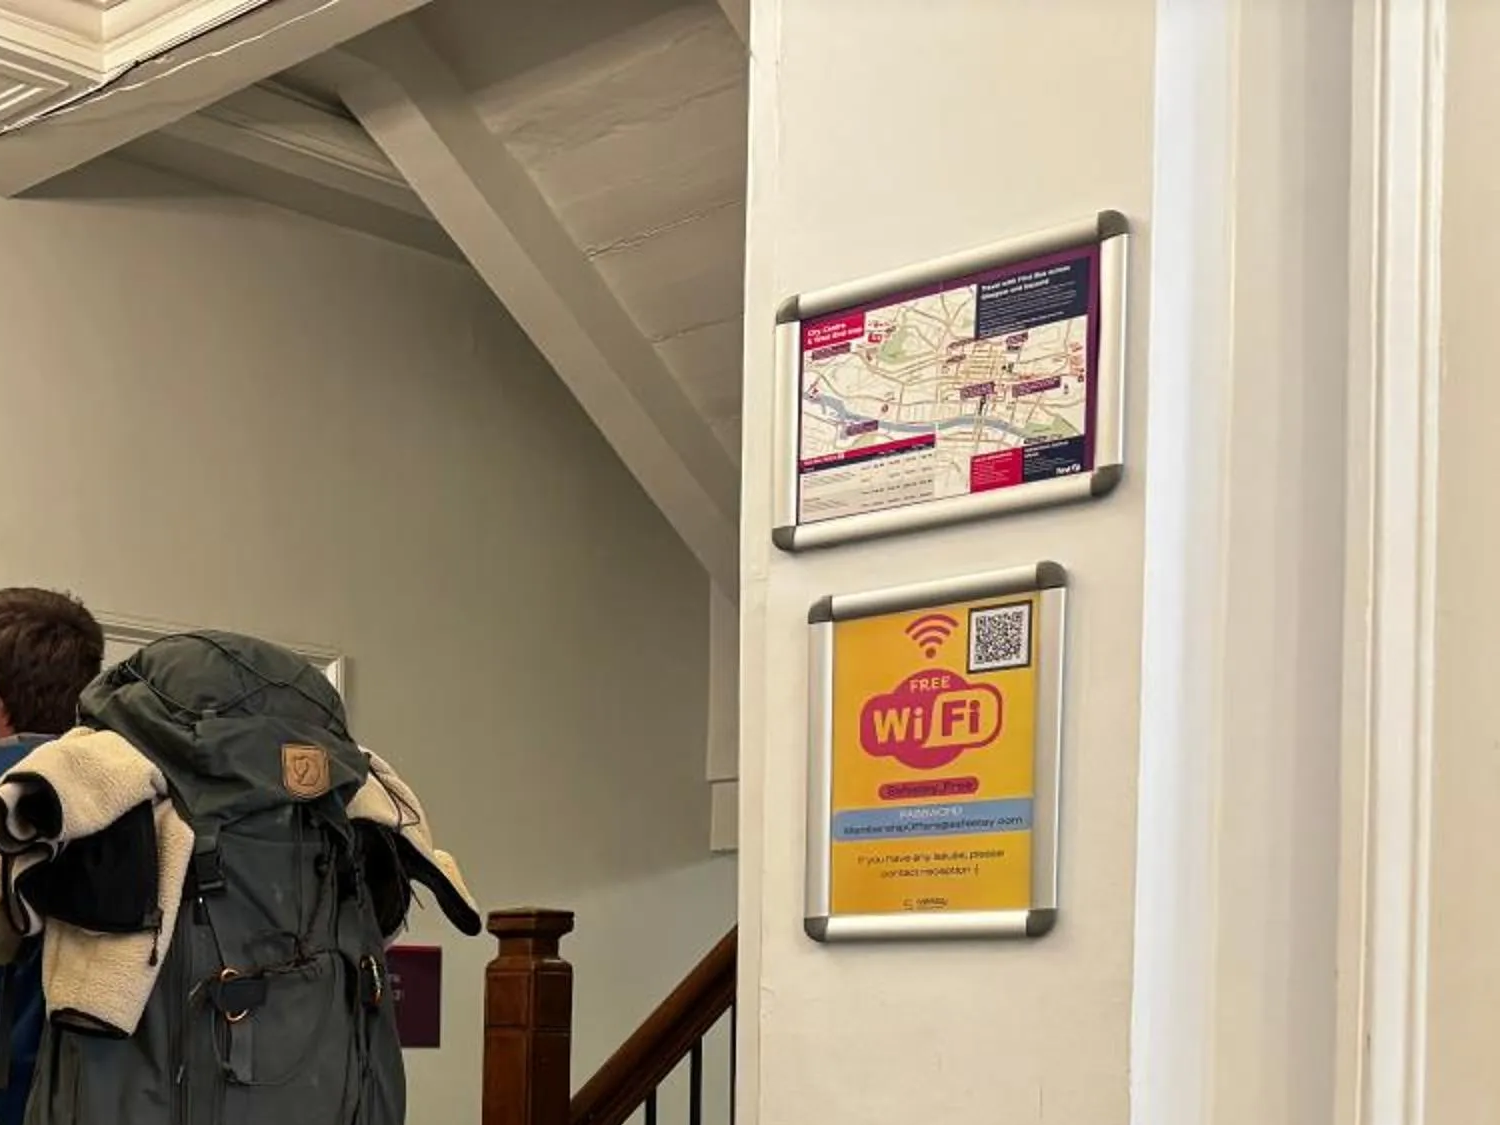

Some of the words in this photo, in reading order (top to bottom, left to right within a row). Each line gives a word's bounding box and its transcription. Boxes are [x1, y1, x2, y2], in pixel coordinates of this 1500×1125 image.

[909, 675, 951, 692] FREE
[867, 856, 884, 867] you
[884, 854, 911, 863] have
